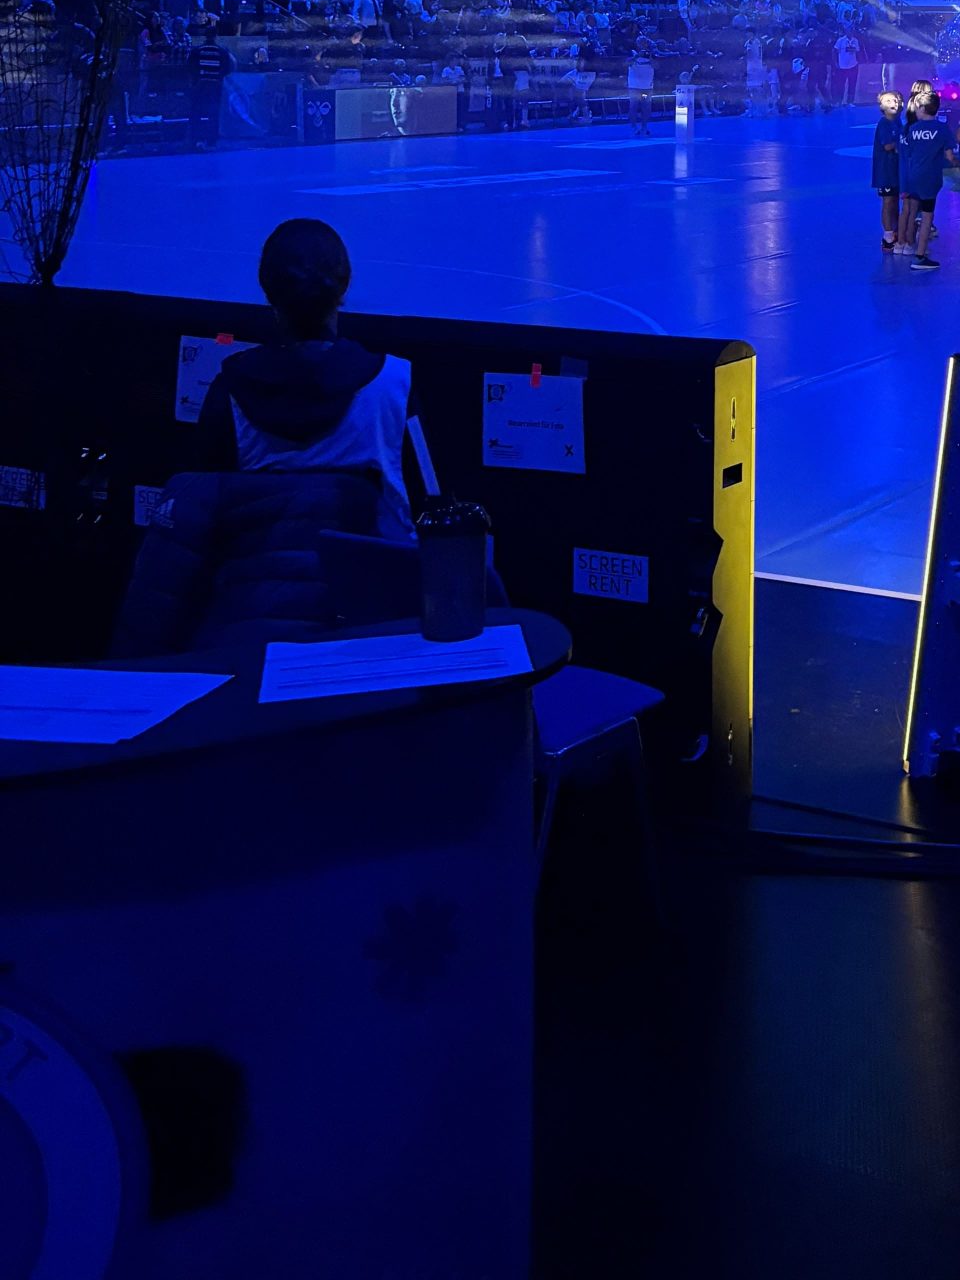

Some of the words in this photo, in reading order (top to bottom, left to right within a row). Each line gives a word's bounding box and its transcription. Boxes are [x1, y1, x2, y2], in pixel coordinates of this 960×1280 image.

[912, 130, 938, 141] WGV
[578, 553, 642, 577] SCREEN
[589, 573, 632, 596] RENT
